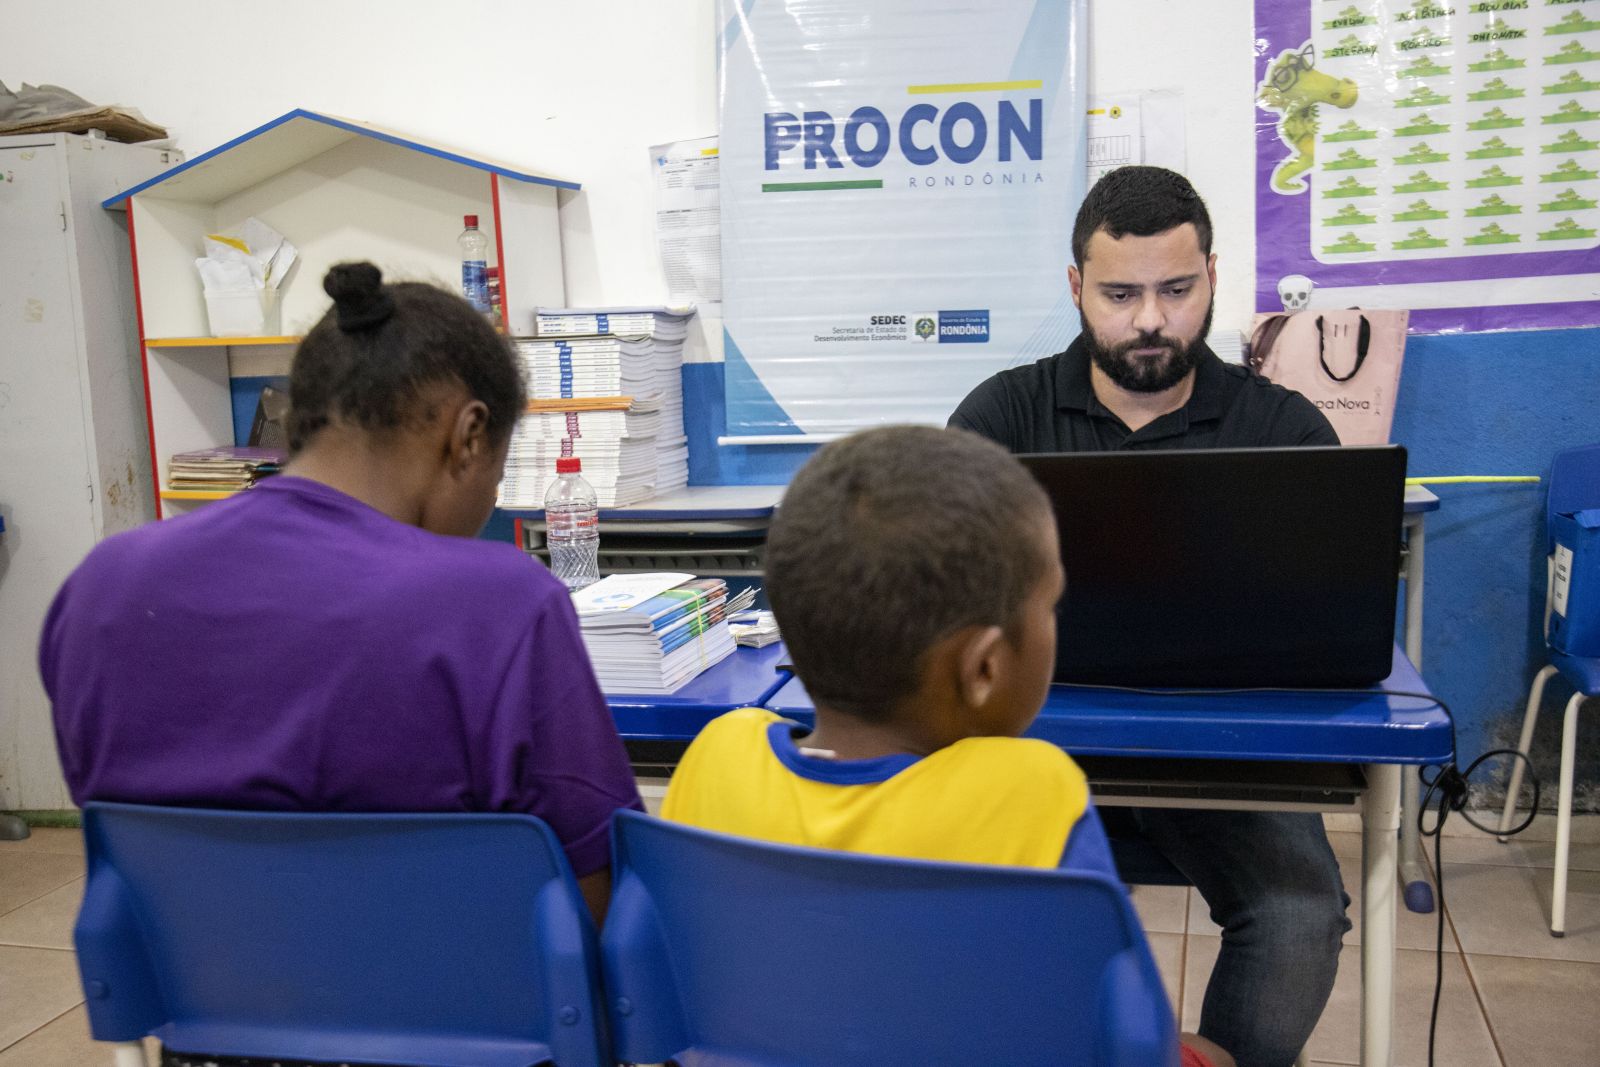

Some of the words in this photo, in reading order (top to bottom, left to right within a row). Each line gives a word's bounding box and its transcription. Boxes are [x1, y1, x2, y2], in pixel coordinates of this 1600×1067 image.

[764, 98, 1043, 170] PROCON
[909, 172, 1044, 188] RONDÔNIA
[870, 315, 906, 326] SEDEC
[875, 326, 897, 334] Estado
[941, 323, 988, 335] RONDÔNIA
[1337, 397, 1369, 409] Nova
